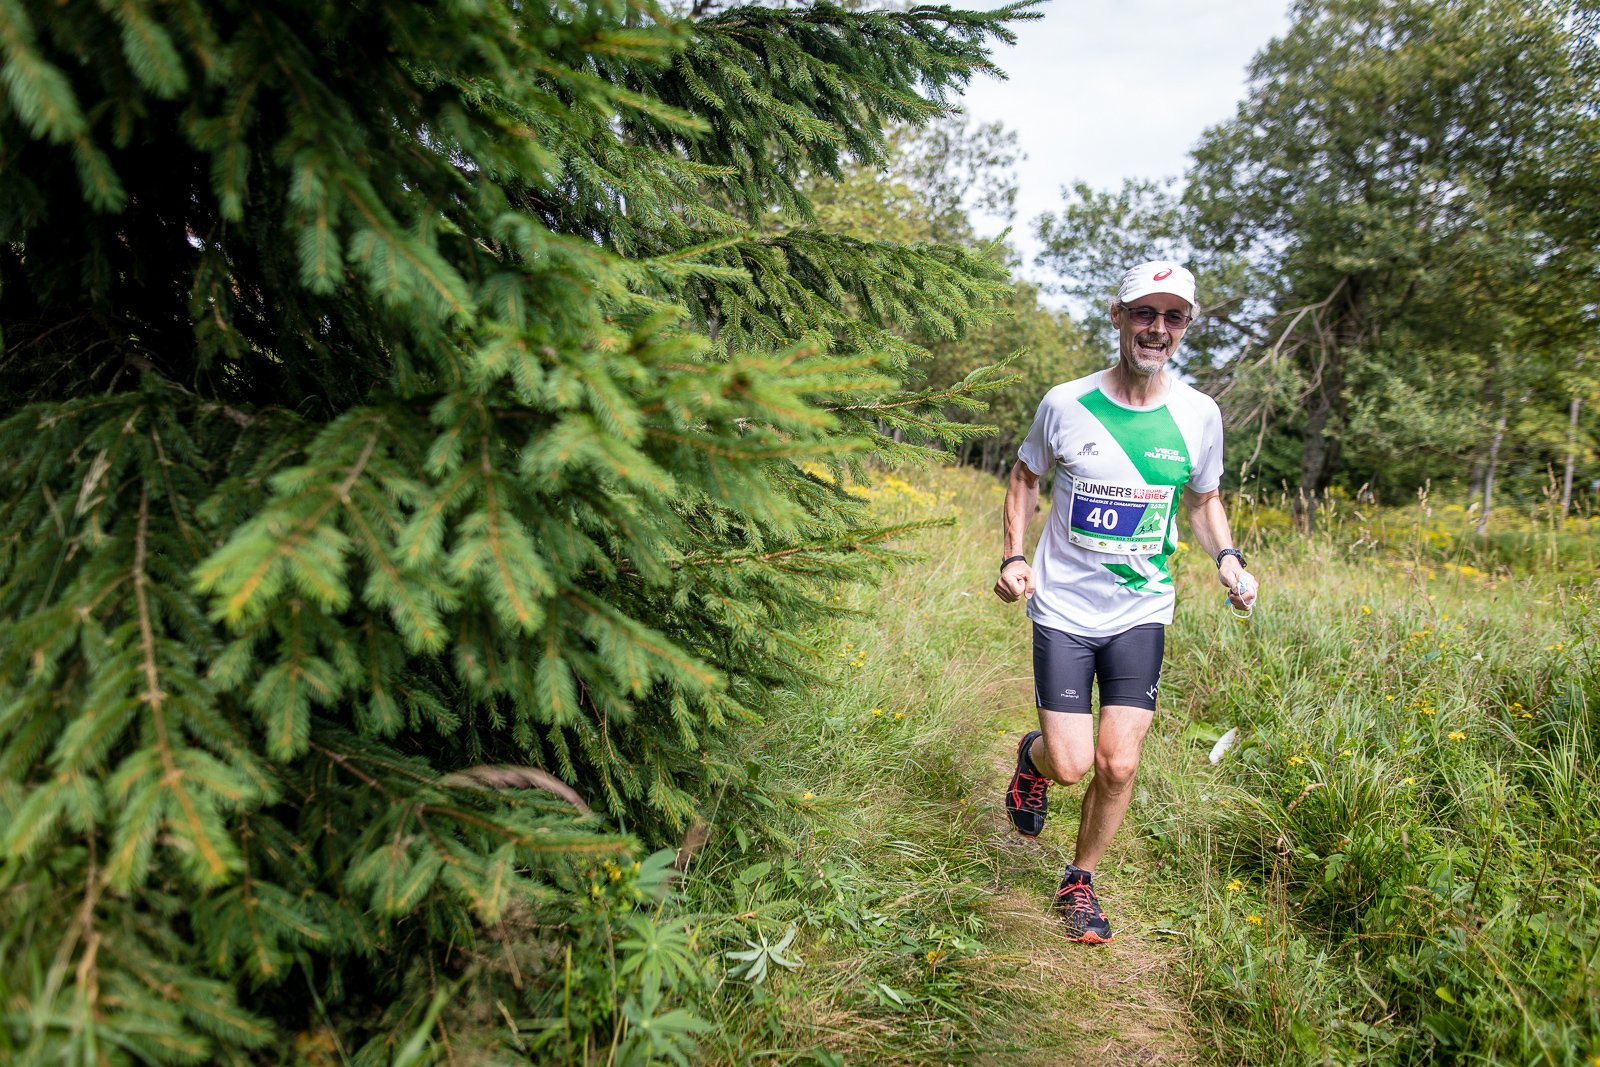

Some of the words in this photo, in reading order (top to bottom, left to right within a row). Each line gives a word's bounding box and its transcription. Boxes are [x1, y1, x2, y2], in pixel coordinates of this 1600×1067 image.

[1144, 451, 1186, 463] RUNNERS
[1154, 447, 1179, 456] VEGE
[1086, 507, 1119, 530] 40
